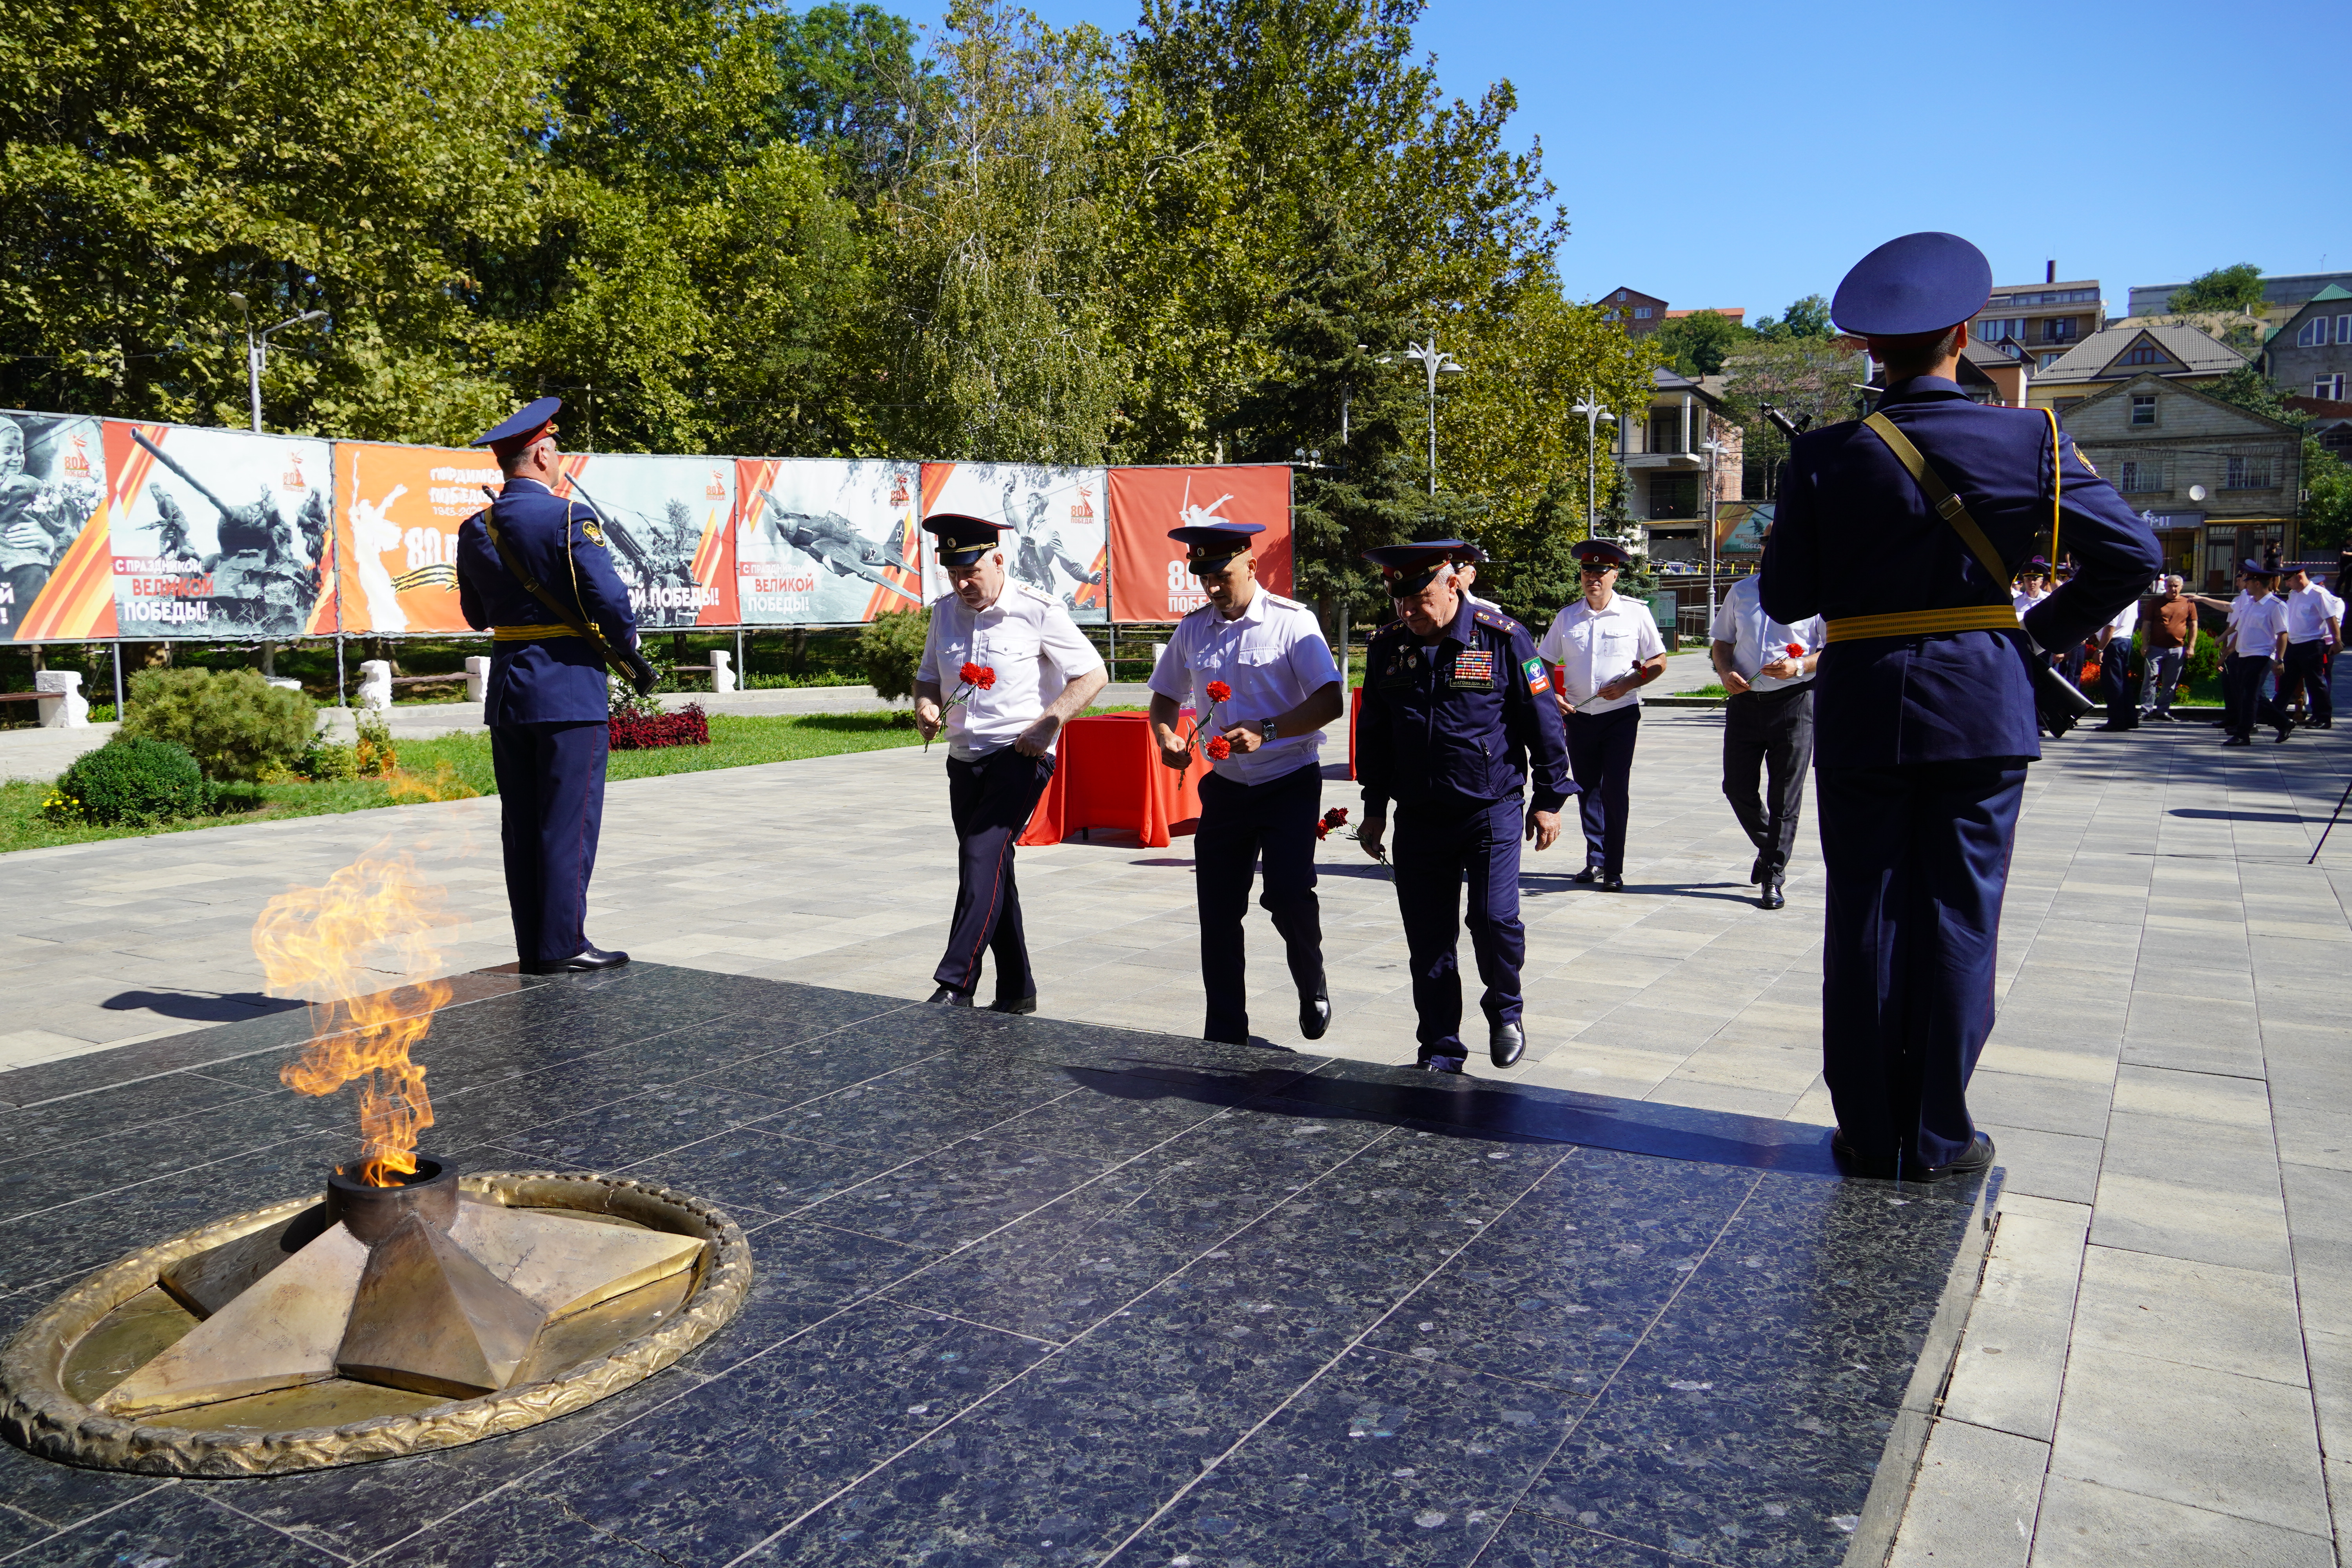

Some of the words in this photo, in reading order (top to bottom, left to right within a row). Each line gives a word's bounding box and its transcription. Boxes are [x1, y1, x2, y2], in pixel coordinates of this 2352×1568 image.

[65, 456, 78, 468] 80
[706, 486, 716, 494] 80
[891, 490, 900, 500] 80
[1071, 505, 1083, 516] 80
[404, 527, 442, 570] 80
[115, 561, 124, 572] С
[126, 559, 202, 574] ПРАЗДНИКОМ
[743, 564, 749, 573] С
[751, 564, 804, 575] ПРАЗДНИКОМ
[133, 573, 214, 596] ВЕЛИКОЙ
[755, 573, 814, 592] ВЕЛИКОЙ
[650, 587, 719, 610] ПОБЕДЫ!
[748, 596, 810, 614] ПОБЕДЫ!
[124, 601, 209, 624] ПОБЕДЫ!
